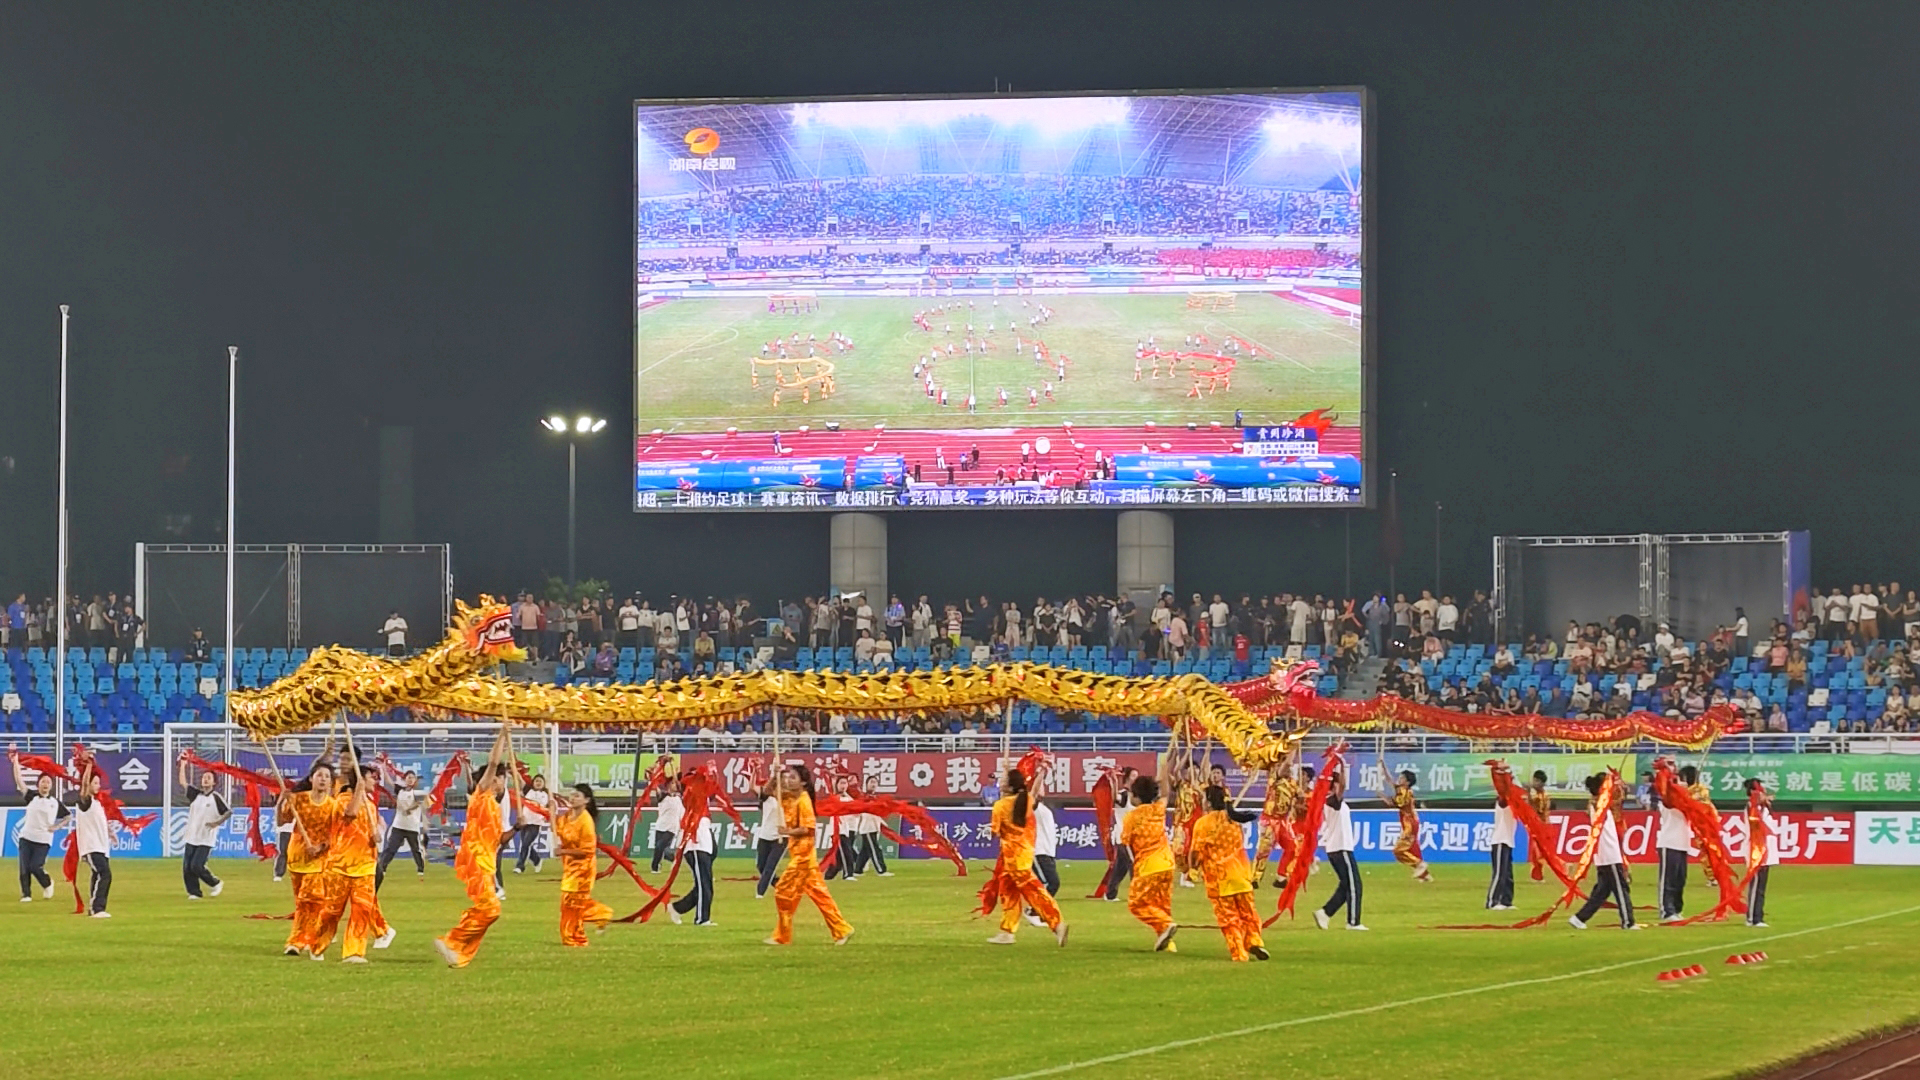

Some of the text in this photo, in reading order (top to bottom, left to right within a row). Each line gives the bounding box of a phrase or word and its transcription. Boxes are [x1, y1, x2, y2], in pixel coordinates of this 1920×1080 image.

[1698, 771, 1920, 792] 分类就是低碳
